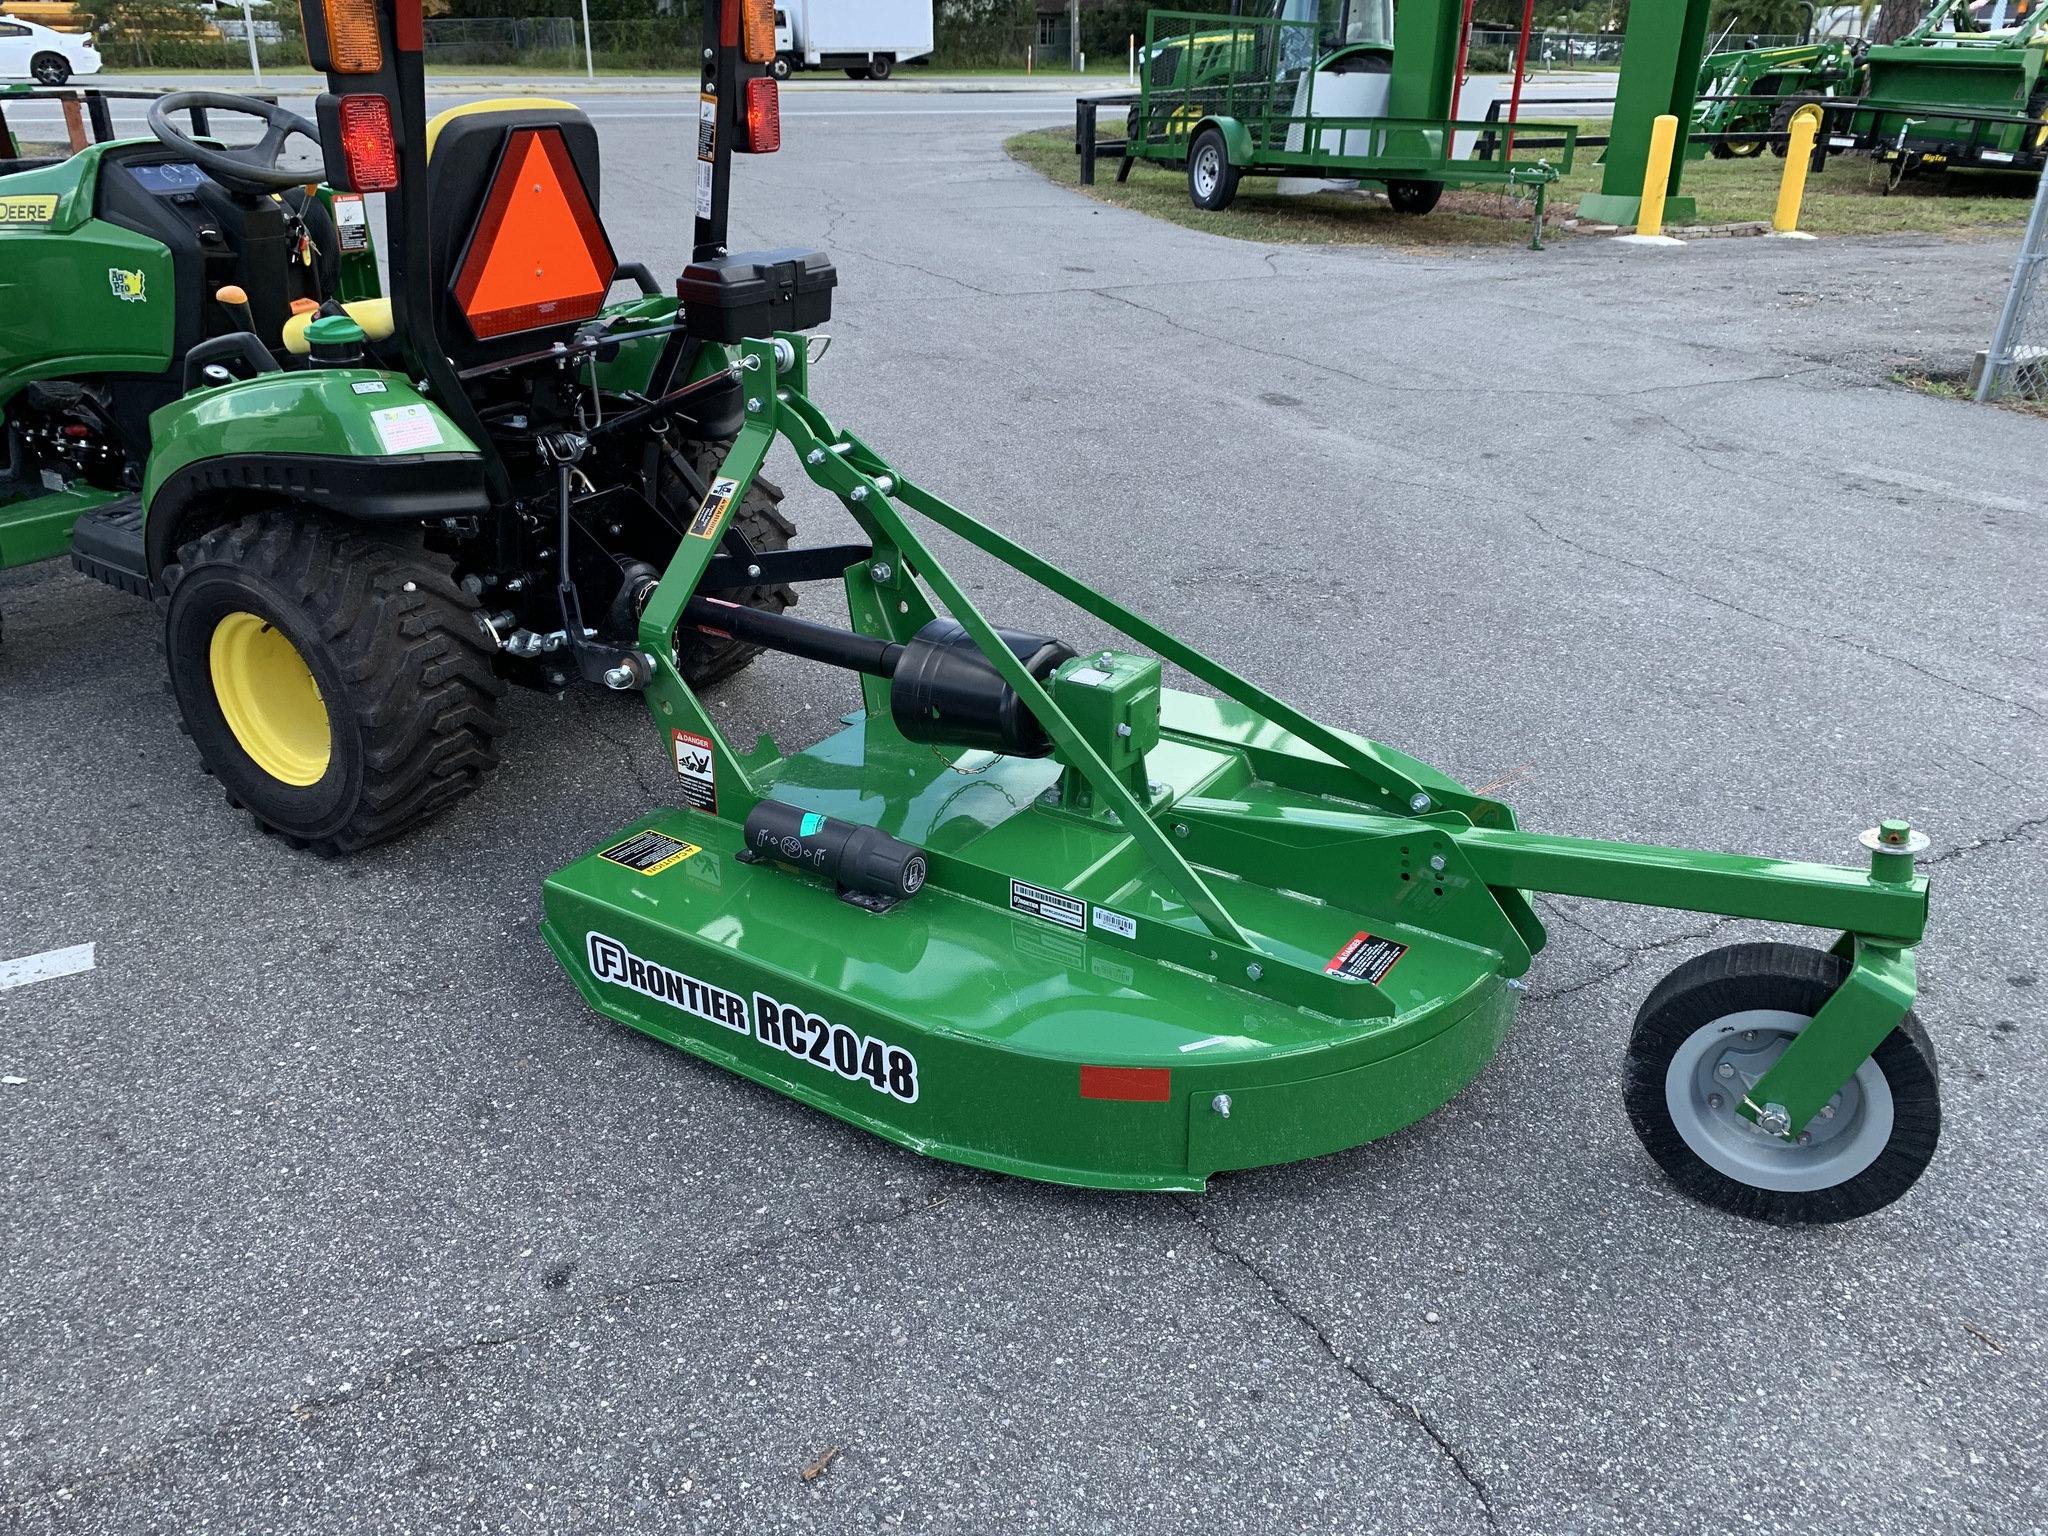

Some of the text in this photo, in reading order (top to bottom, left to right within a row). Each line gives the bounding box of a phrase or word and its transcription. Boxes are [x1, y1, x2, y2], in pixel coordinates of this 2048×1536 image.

[1922, 153, 1948, 162] BigTex
[114, 281, 131, 293] Pro
[705, 503, 724, 536] WARNING
[683, 734, 708, 748] DANGER
[646, 851, 688, 874] CAUTION
[1341, 938, 1363, 958] DANGER
[590, 934, 915, 1099] FRONTIER RC2048
